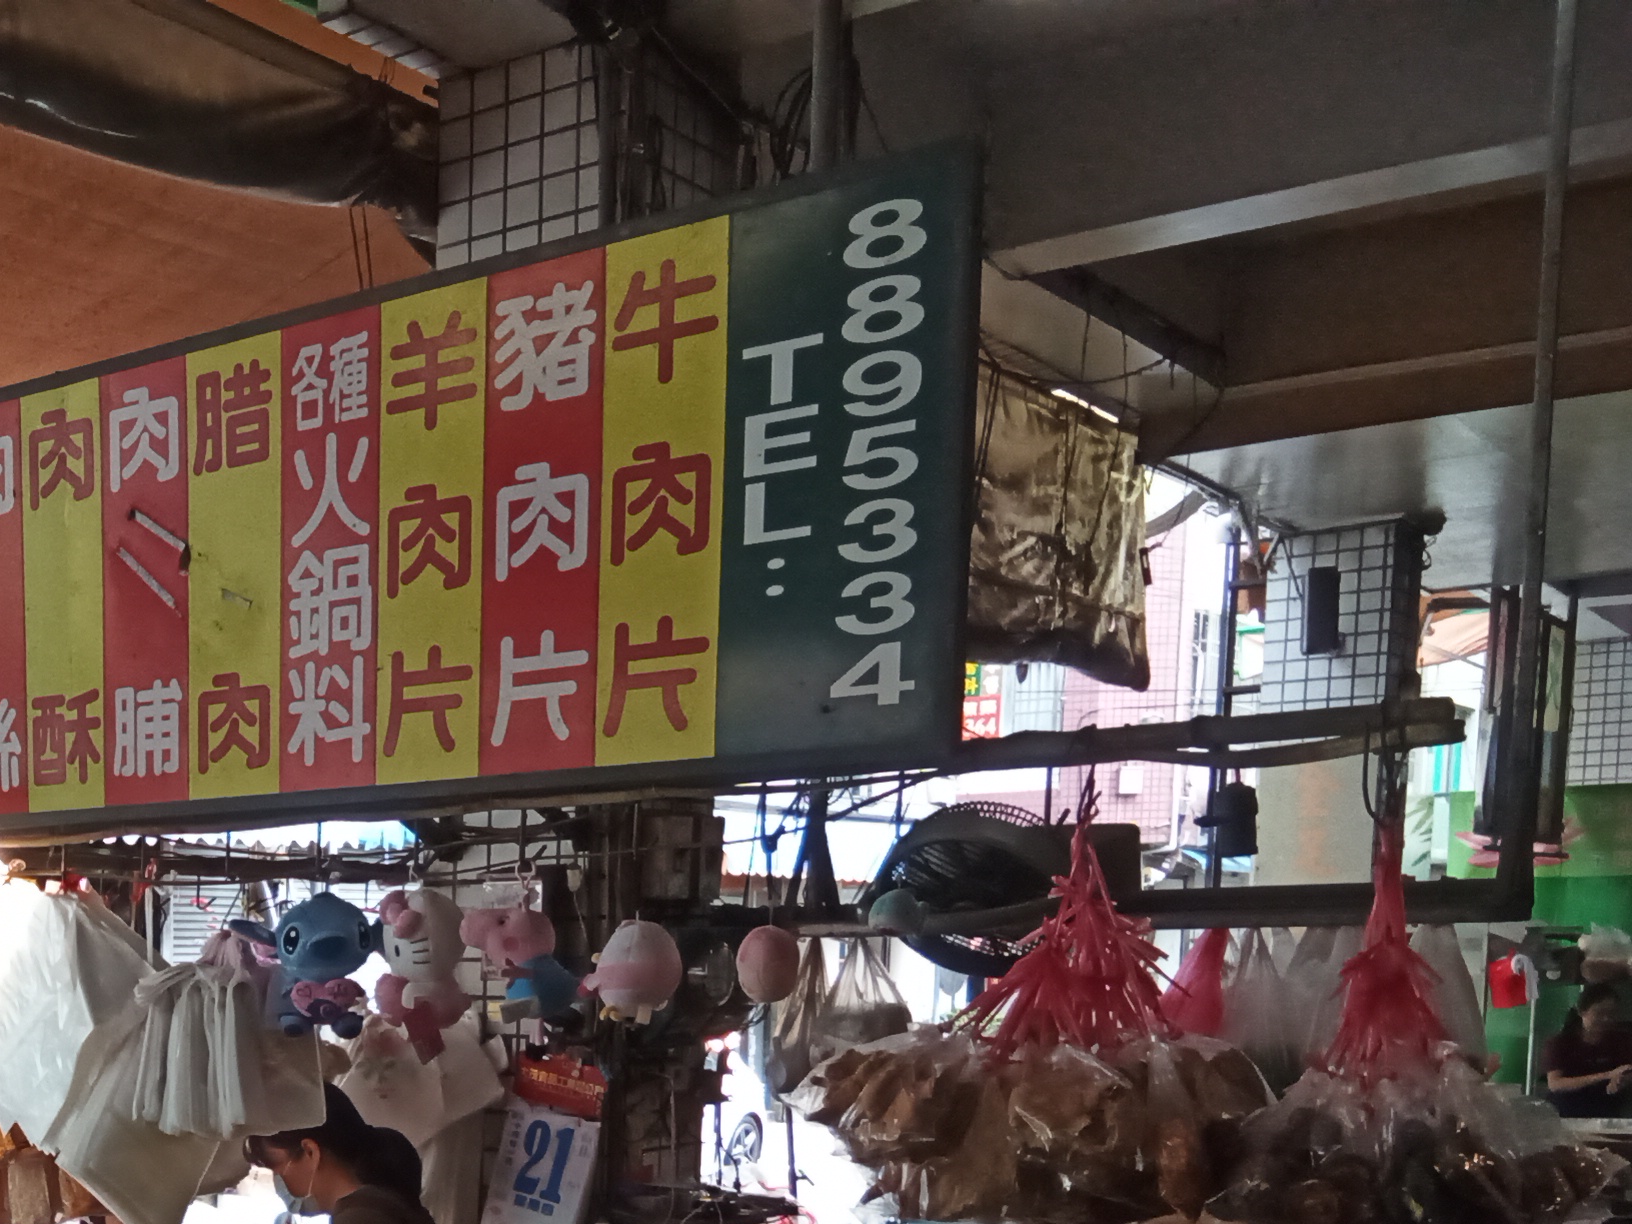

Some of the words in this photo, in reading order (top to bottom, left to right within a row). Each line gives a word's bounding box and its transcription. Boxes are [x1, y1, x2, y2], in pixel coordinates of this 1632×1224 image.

[28, 407, 102, 787] 肉酥
[108, 386, 183, 778] 肉脯
[192, 358, 273, 775] 腊肉
[287, 331, 372, 767] 各種火鍋料
[381, 310, 478, 758] 羊肉片
[490, 280, 597, 748] 豬肉片
[602, 258, 720, 738] 牛肉片
[829, 198, 928, 706] 8895334
[513, 1119, 575, 1204] 21
